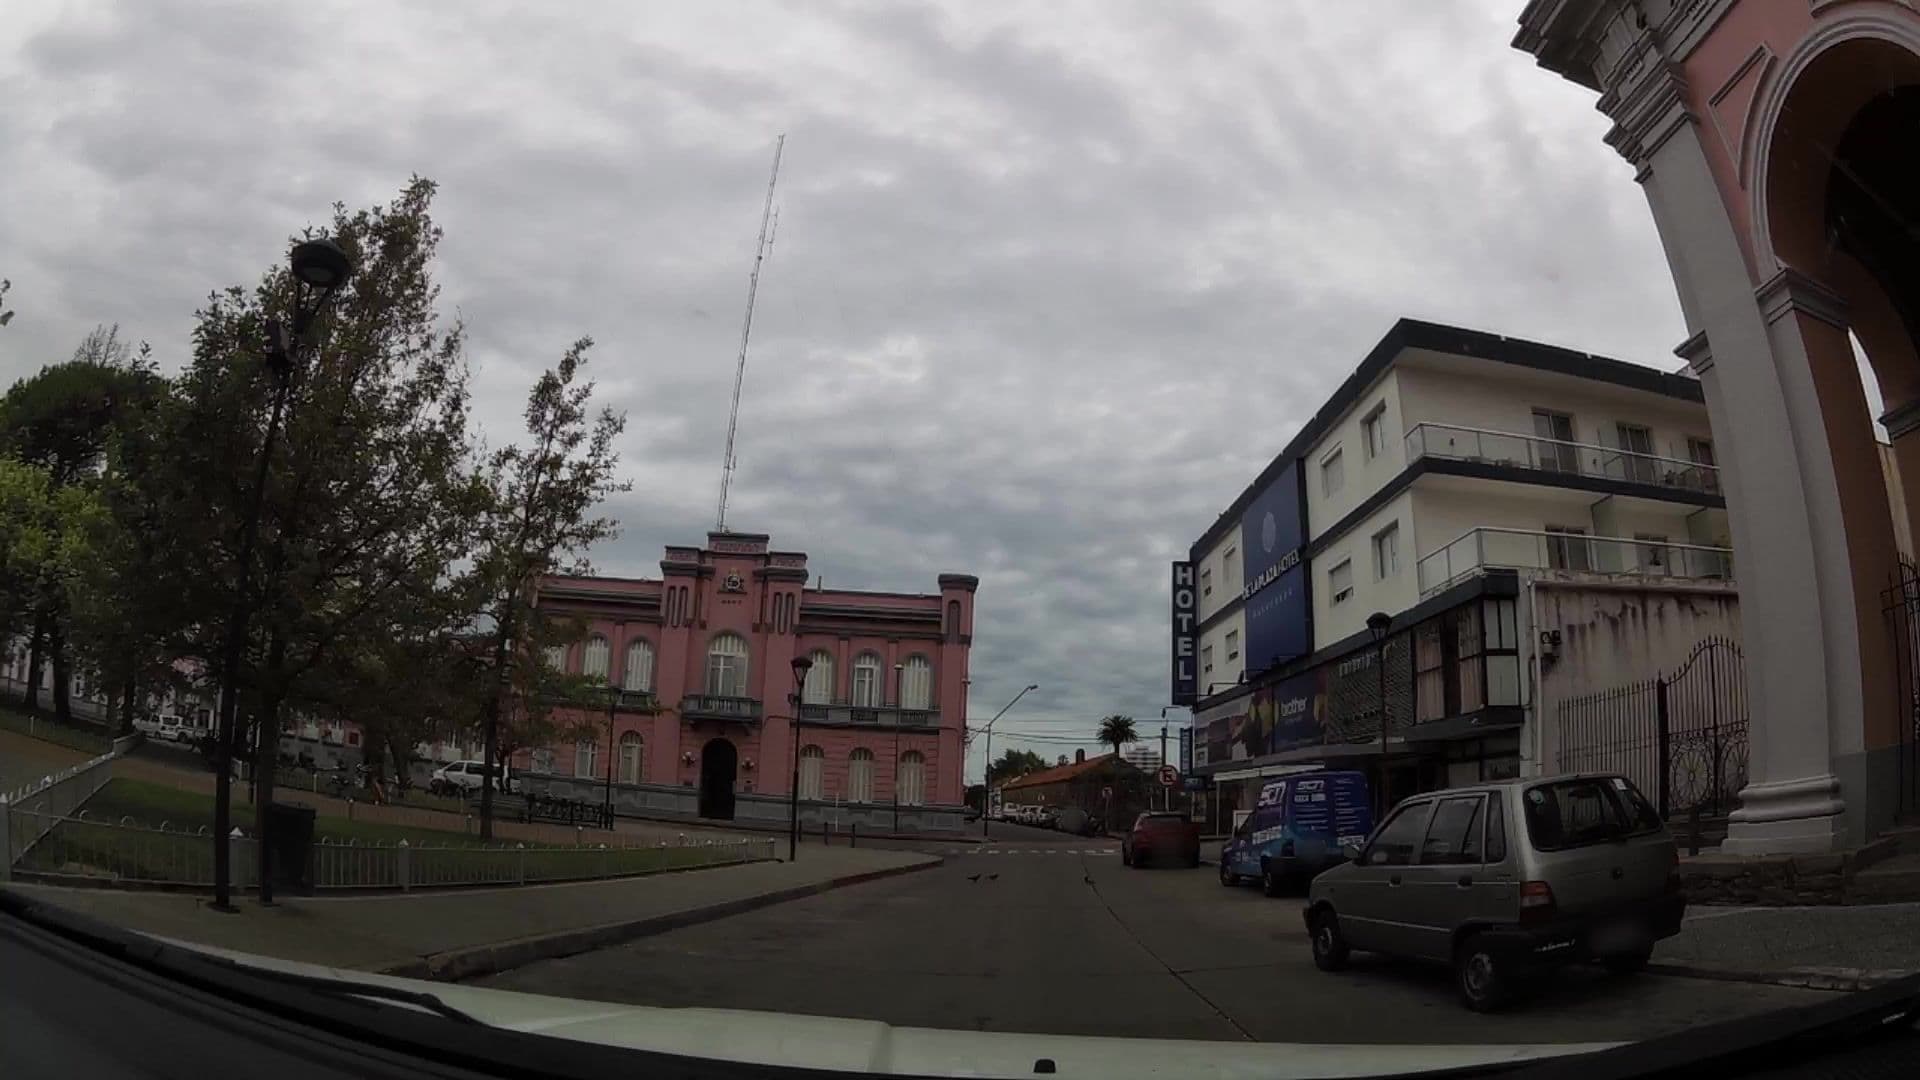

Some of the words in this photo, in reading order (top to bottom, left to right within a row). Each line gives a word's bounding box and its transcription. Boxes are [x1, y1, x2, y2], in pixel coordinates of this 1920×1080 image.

[1278, 549, 1300, 573] HOTEL
[1176, 565, 1194, 681] HOTEL
[1280, 696, 1308, 716] brother
